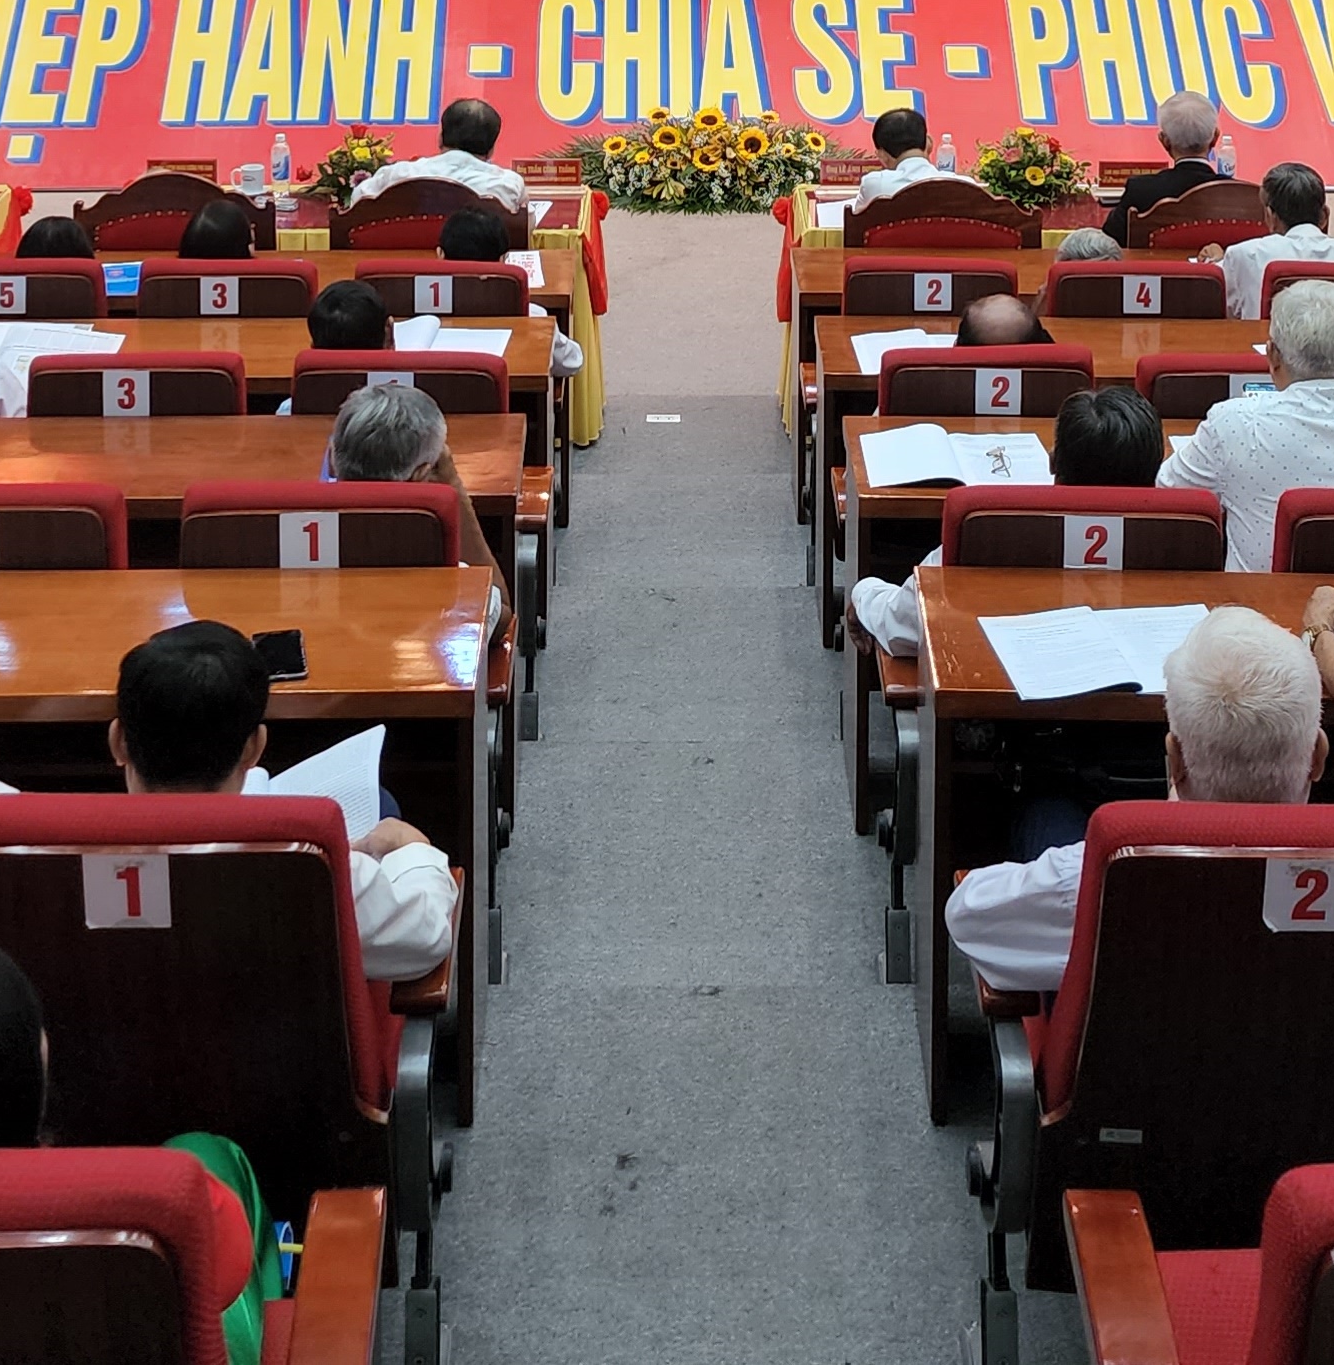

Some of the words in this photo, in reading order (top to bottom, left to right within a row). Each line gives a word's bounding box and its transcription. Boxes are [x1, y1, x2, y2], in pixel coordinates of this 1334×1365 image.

[0, 282, 14, 307] 5
[213, 282, 228, 308] 3
[430, 282, 441, 307] 1
[927, 279, 942, 304] 2
[1136, 282, 1152, 307] 4
[117, 377, 136, 409] 3
[991, 376, 1010, 407] 2
[302, 521, 320, 561] 1
[1083, 524, 1108, 564] 2
[115, 866, 142, 918] 1
[1290, 870, 1329, 920] 2
